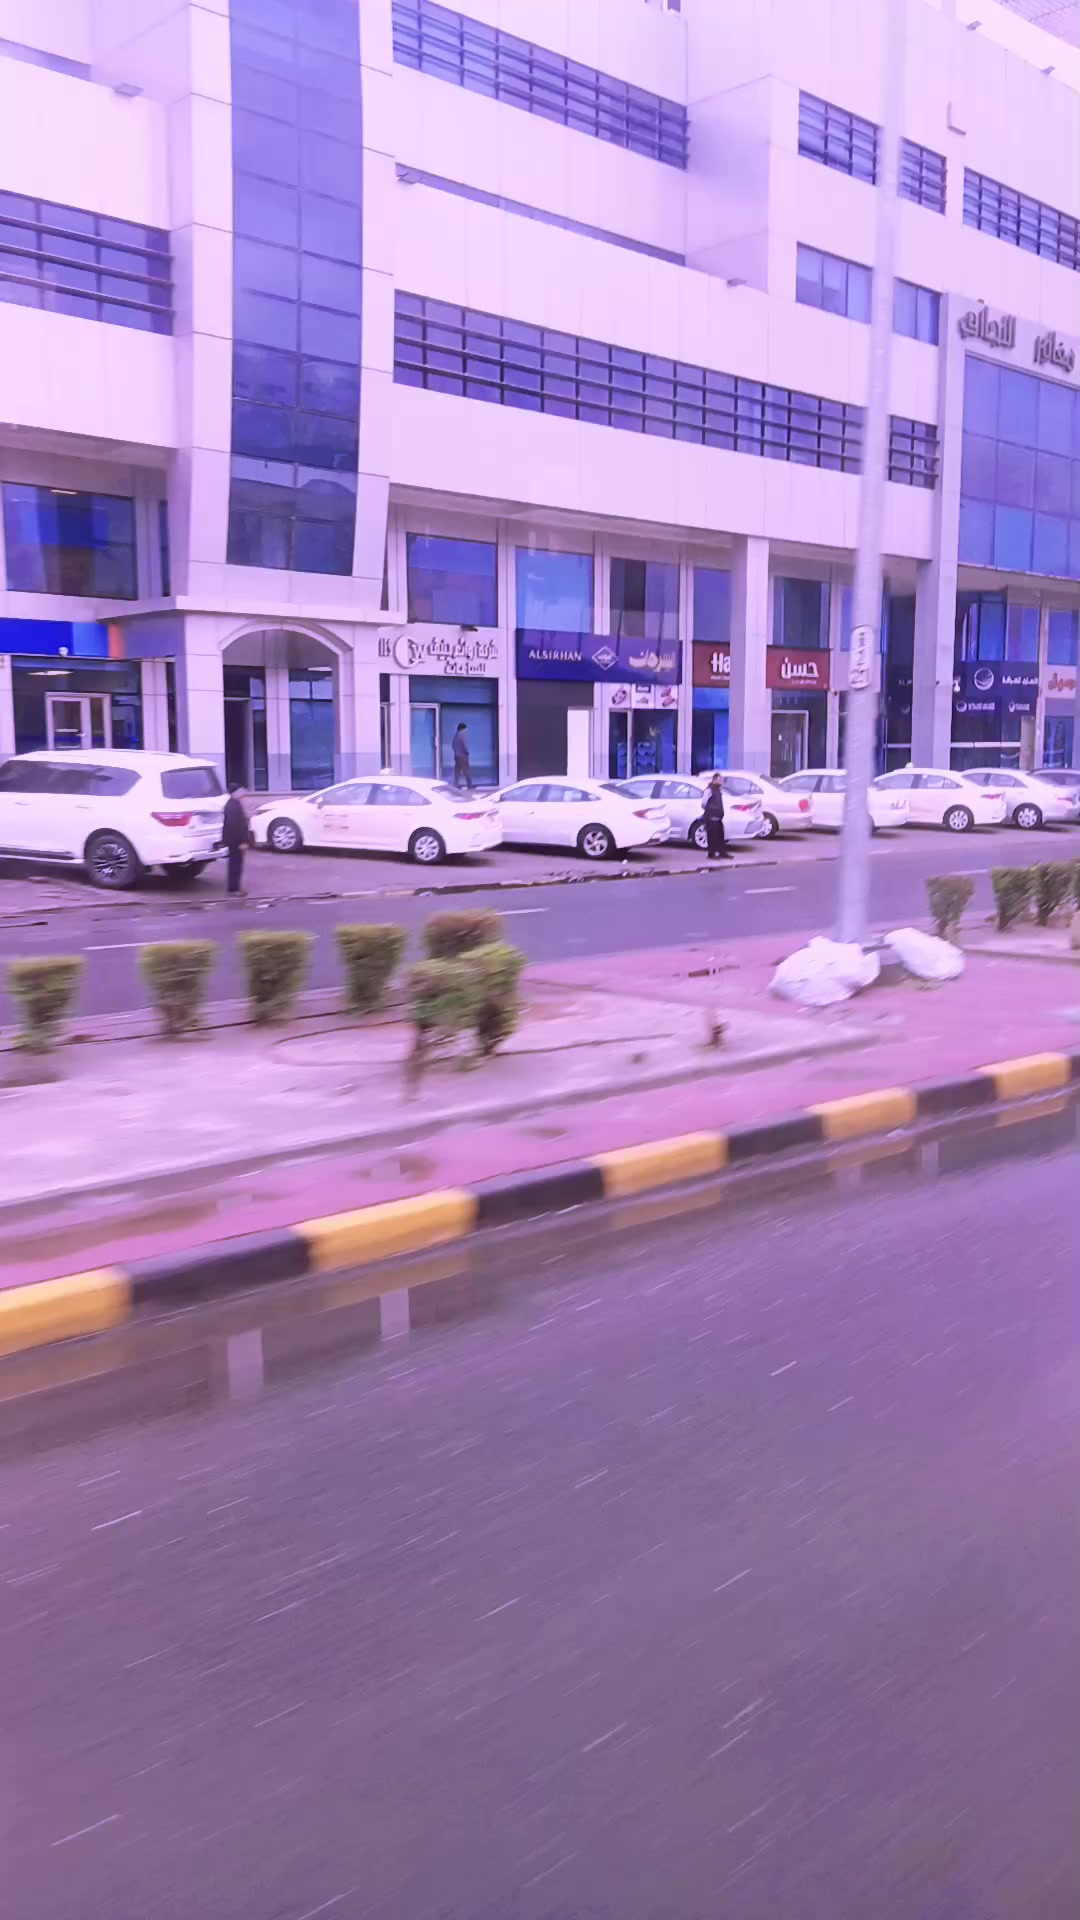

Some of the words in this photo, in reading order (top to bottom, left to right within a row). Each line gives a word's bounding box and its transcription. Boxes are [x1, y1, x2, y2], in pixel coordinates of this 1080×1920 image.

[528, 649, 582, 662] ALSIRHAN
[710, 652, 731, 673] Ha
[781, 656, 819, 679] حسن
